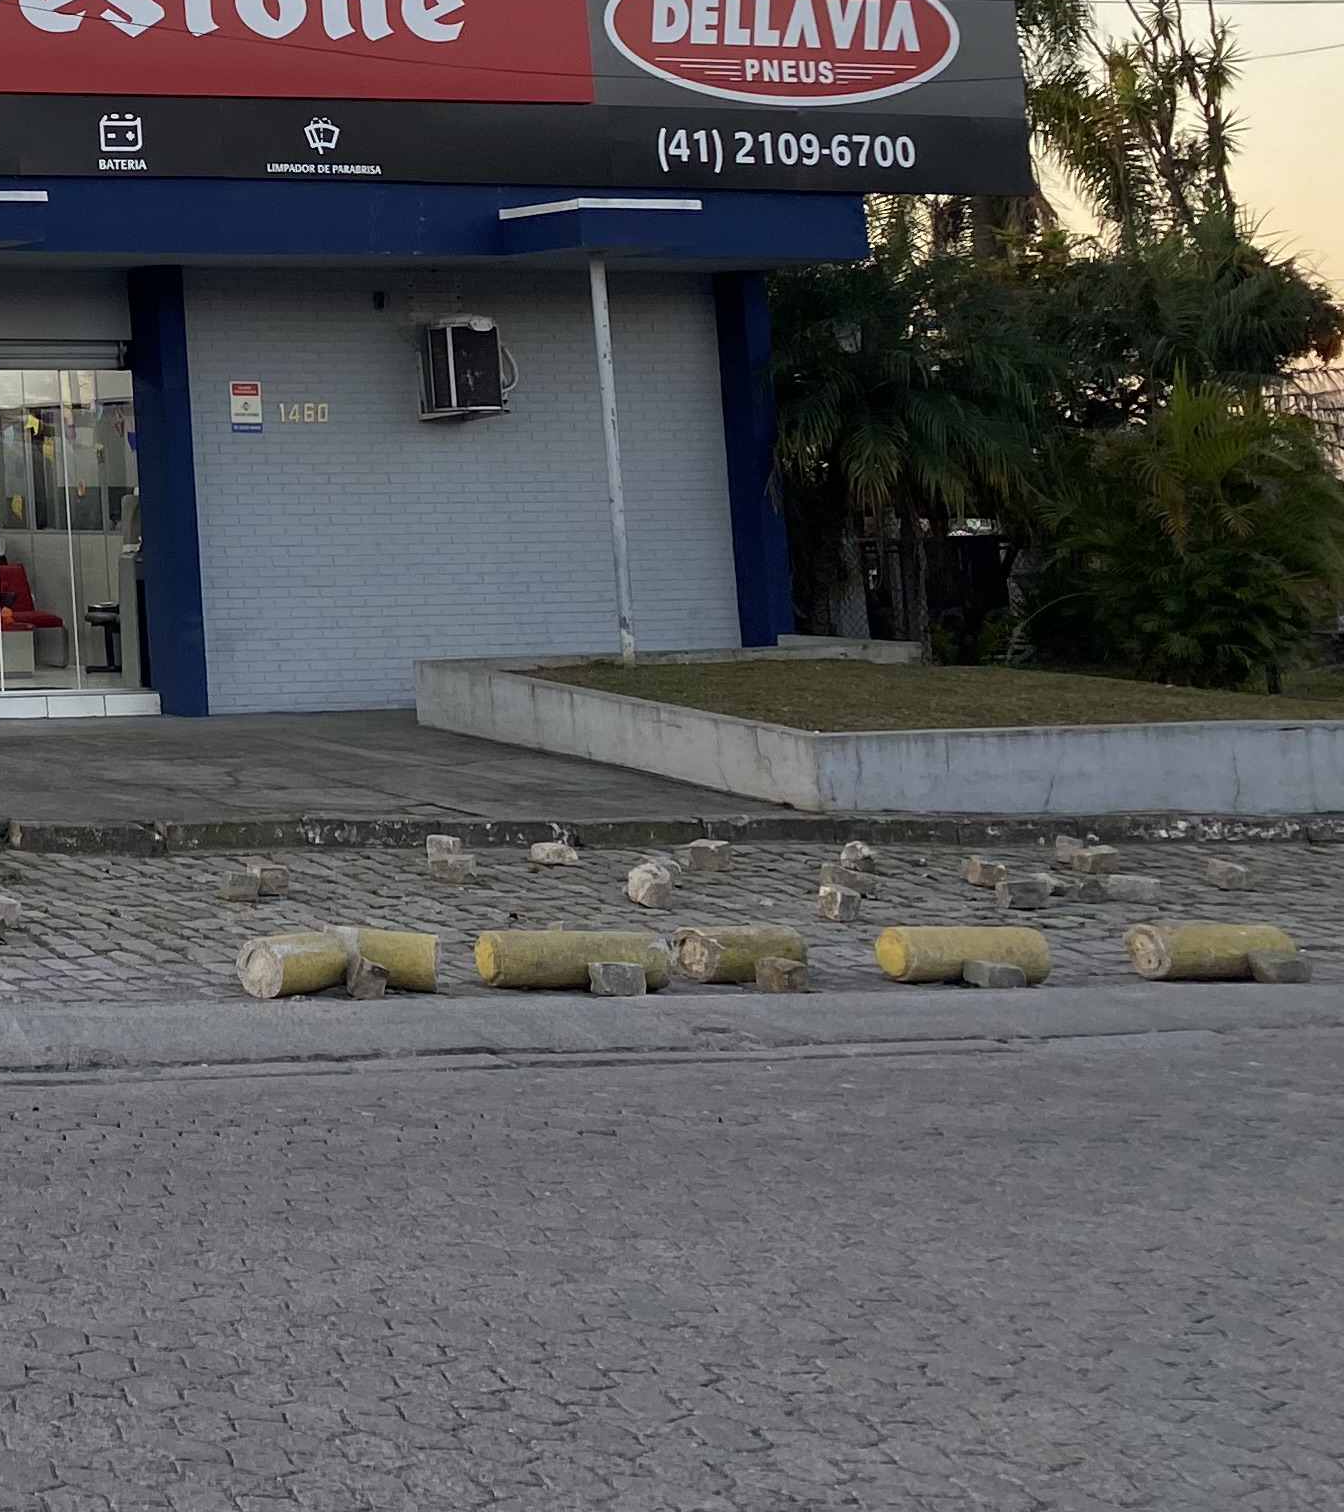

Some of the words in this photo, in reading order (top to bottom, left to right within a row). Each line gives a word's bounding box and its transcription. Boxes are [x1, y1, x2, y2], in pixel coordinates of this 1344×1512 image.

[743, 58, 836, 85] PNEUS
[658, 127, 723, 174] (41)
[734, 131, 916, 168] 2109-6700
[98, 159, 147, 171] BATERIA
[266, 163, 315, 174] LIMPADOR
[317, 164, 330, 174] DE
[332, 165, 382, 175] PARABRISA
[278, 402, 329, 424] 1460
